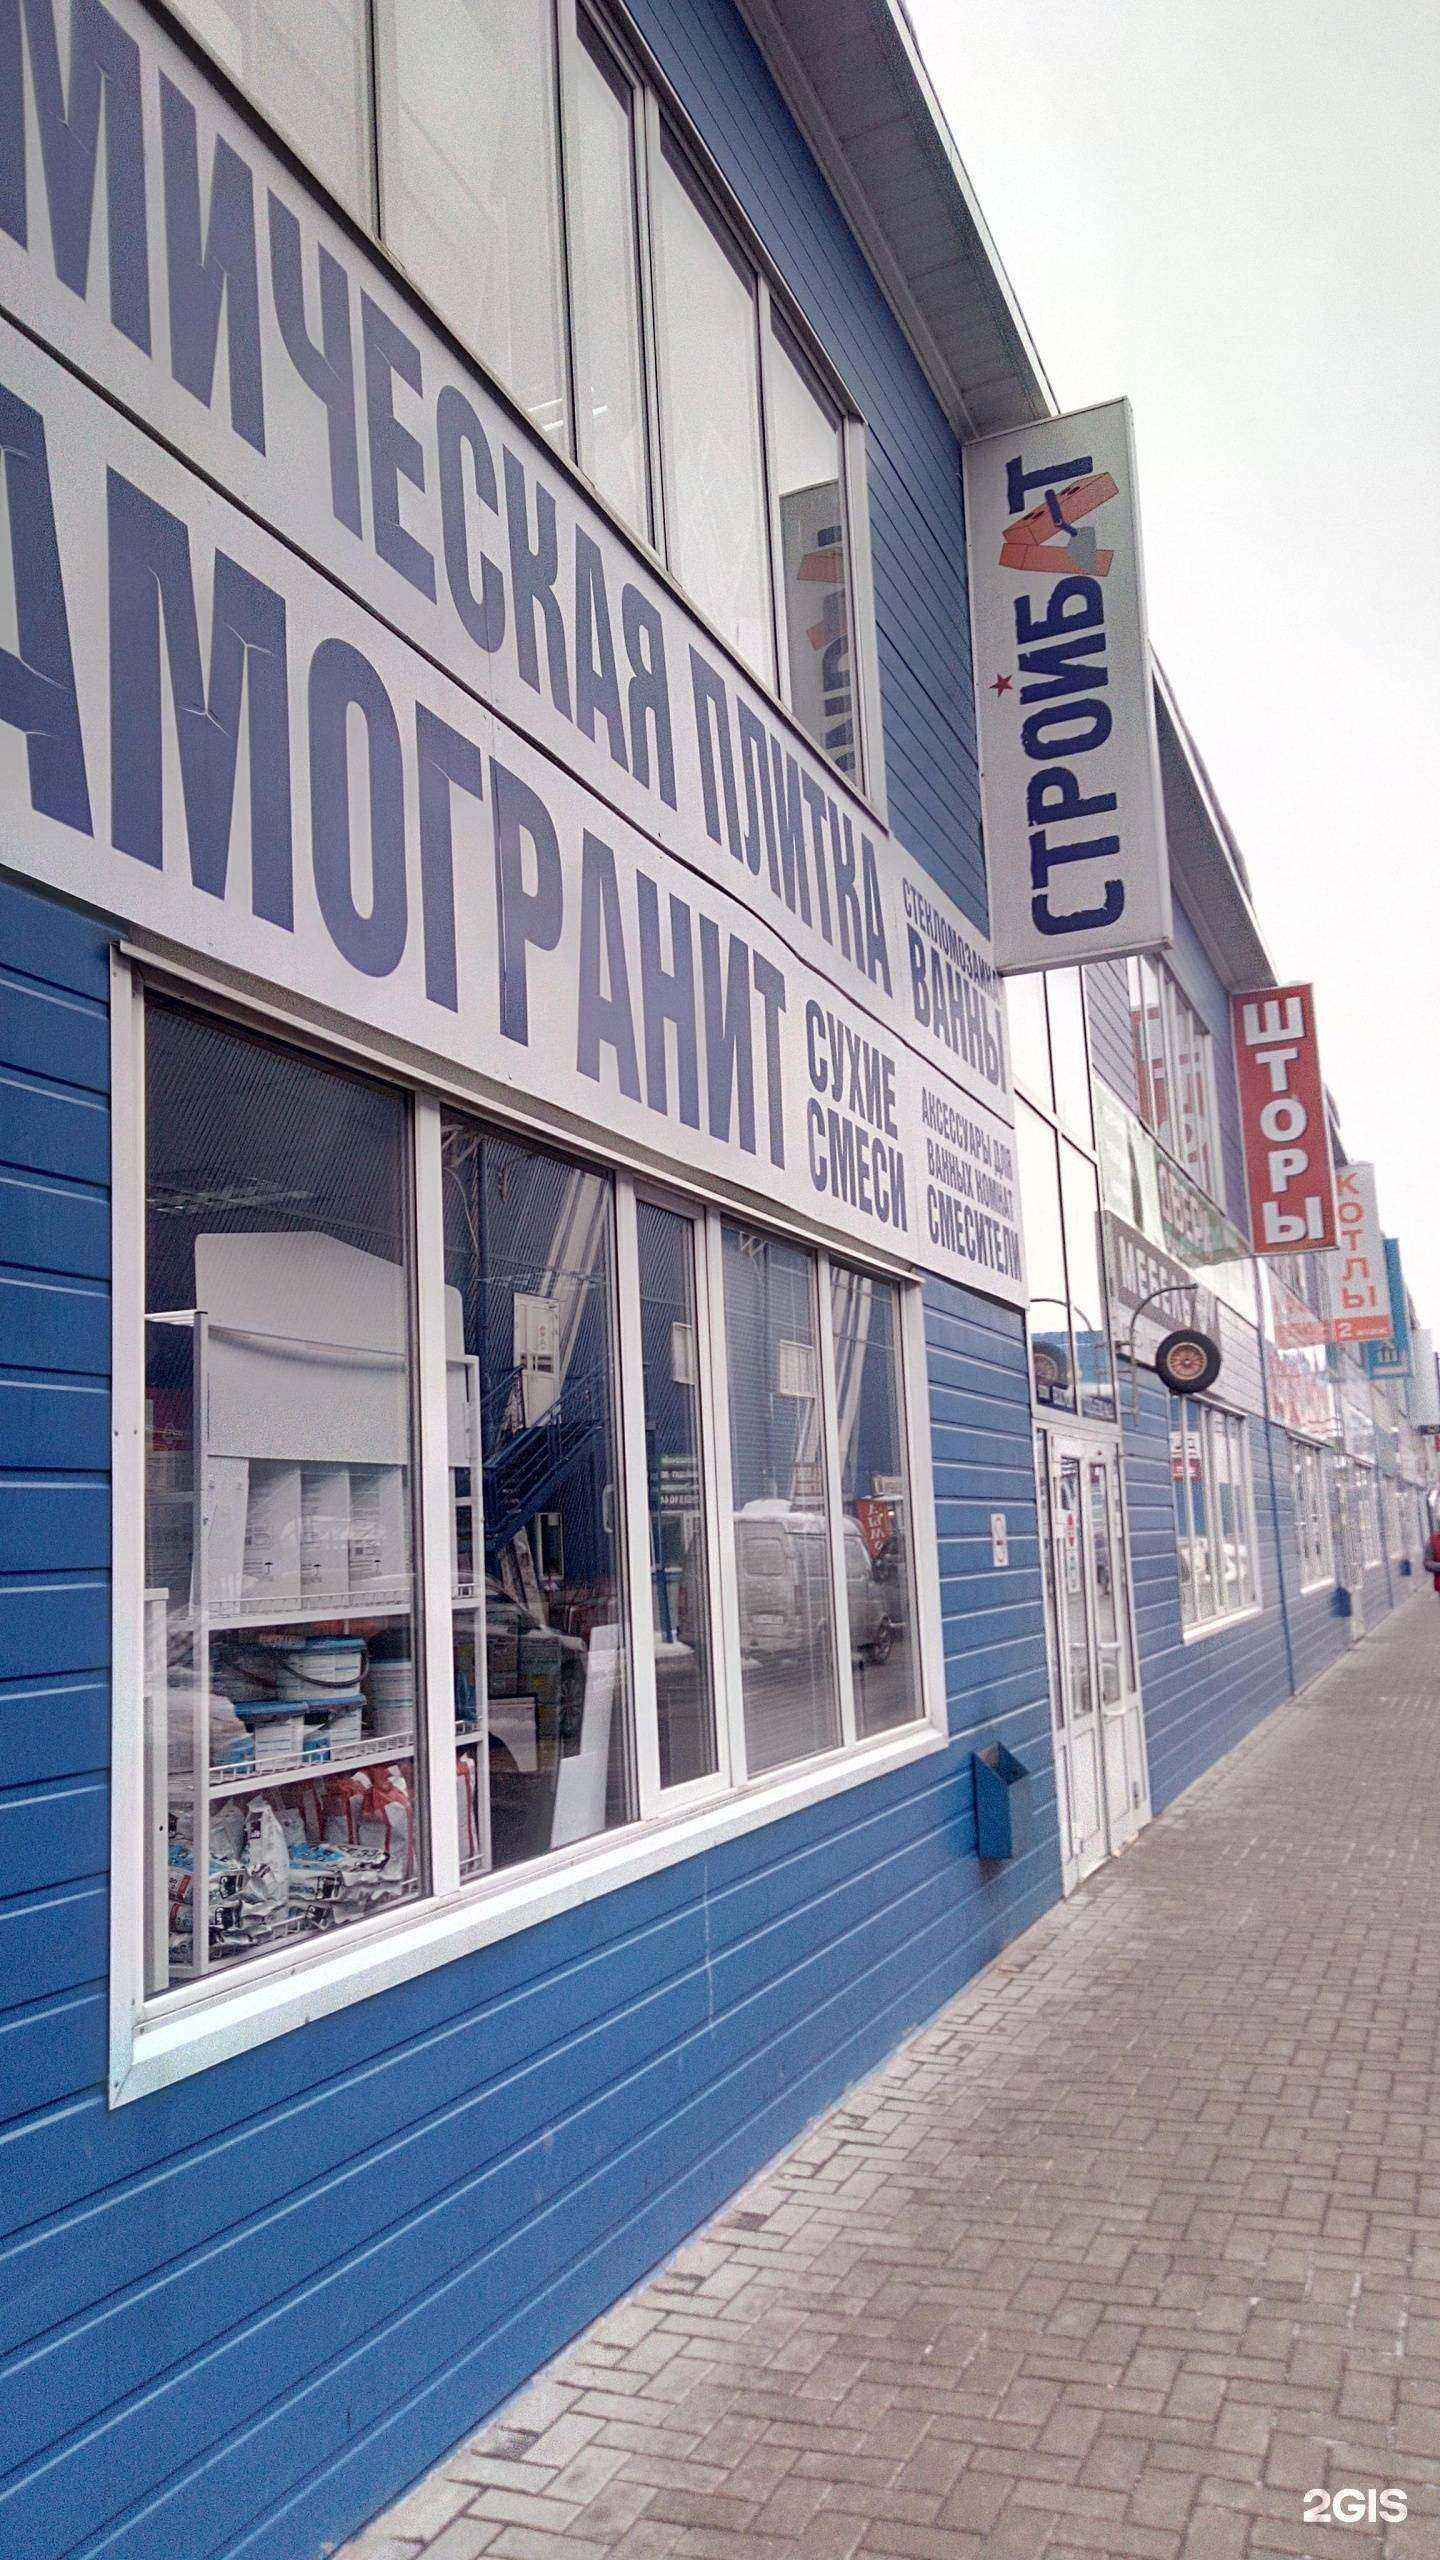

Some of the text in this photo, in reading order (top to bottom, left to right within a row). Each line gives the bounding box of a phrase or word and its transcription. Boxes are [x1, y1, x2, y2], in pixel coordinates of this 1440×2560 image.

[689, 643, 893, 999] ПЛИТКА
[805, 998, 898, 1141] СУХИЕ
[907, 922, 1006, 1095] ВАННЫ
[807, 1096, 908, 1233] СМЕСИ
[922, 1086, 992, 1168] АКСЕССУАРЫ
[926, 1137, 974, 1200] ВАННЫХ
[1243, 995, 1326, 1244] ШТОРЫ
[927, 1184, 1022, 1282] СМЕСИТЕЛИ
[1336, 1172, 1377, 1309] КОТЛЫ
